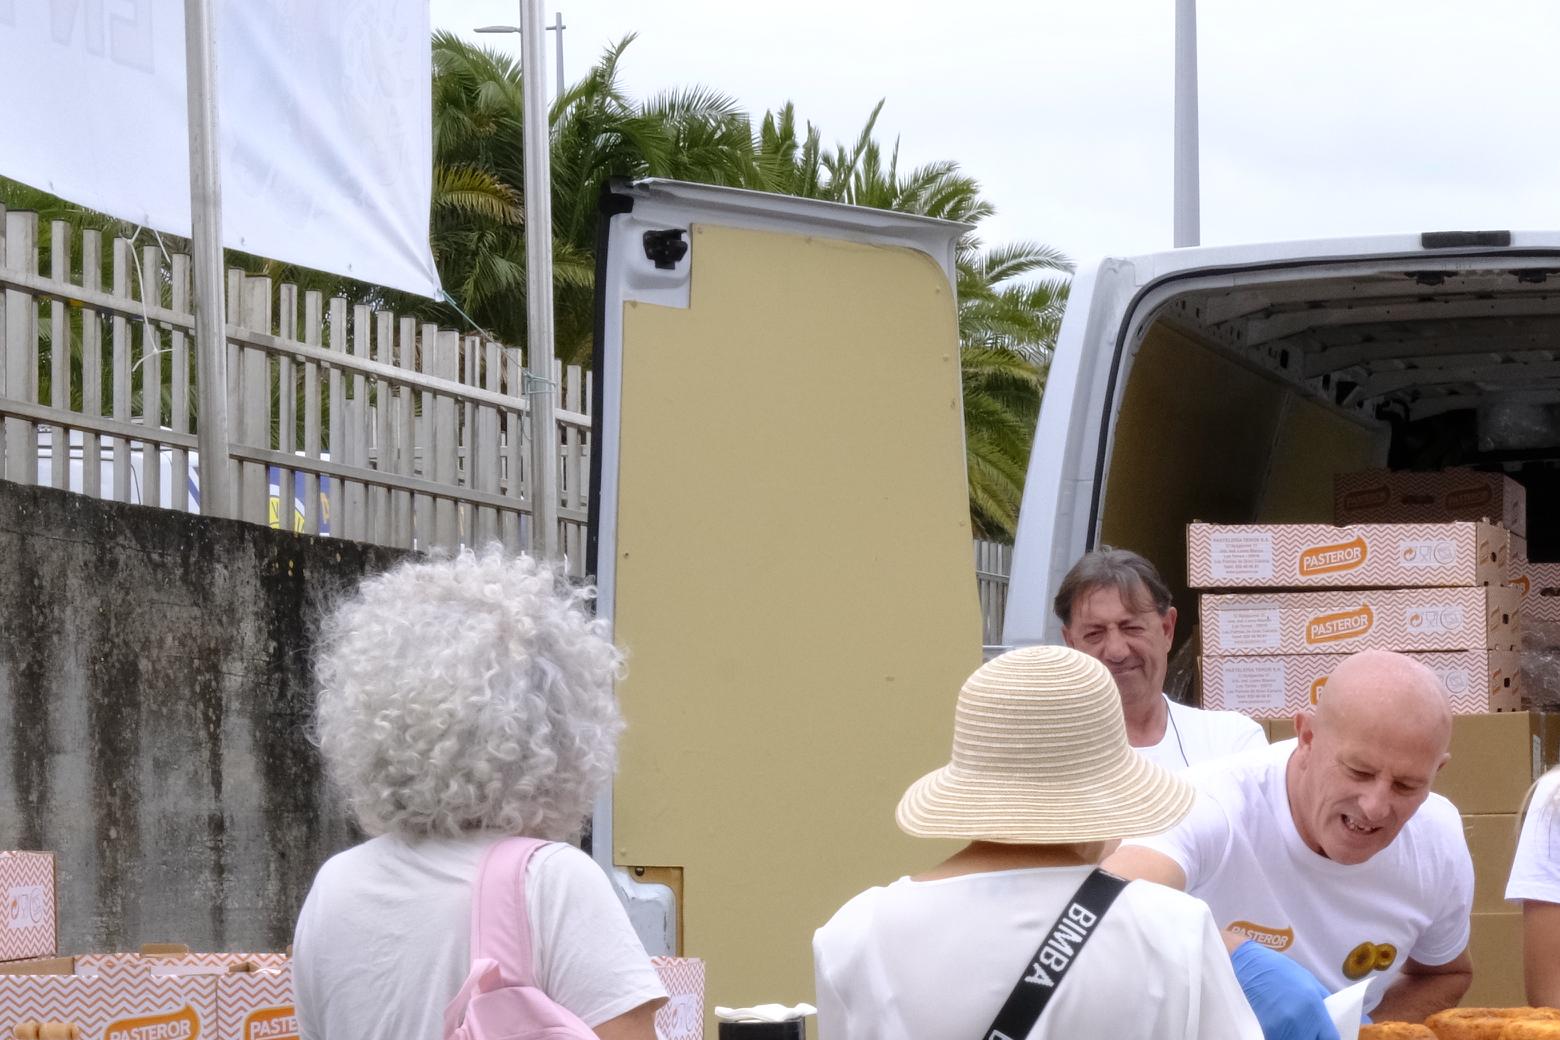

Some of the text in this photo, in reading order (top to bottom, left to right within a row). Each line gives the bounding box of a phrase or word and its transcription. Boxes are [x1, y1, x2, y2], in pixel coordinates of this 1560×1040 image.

[1304, 547, 1362, 571] PASTEROR
[1311, 614, 1369, 639] PASTEROR
[1024, 901, 1098, 988] BIMBA
